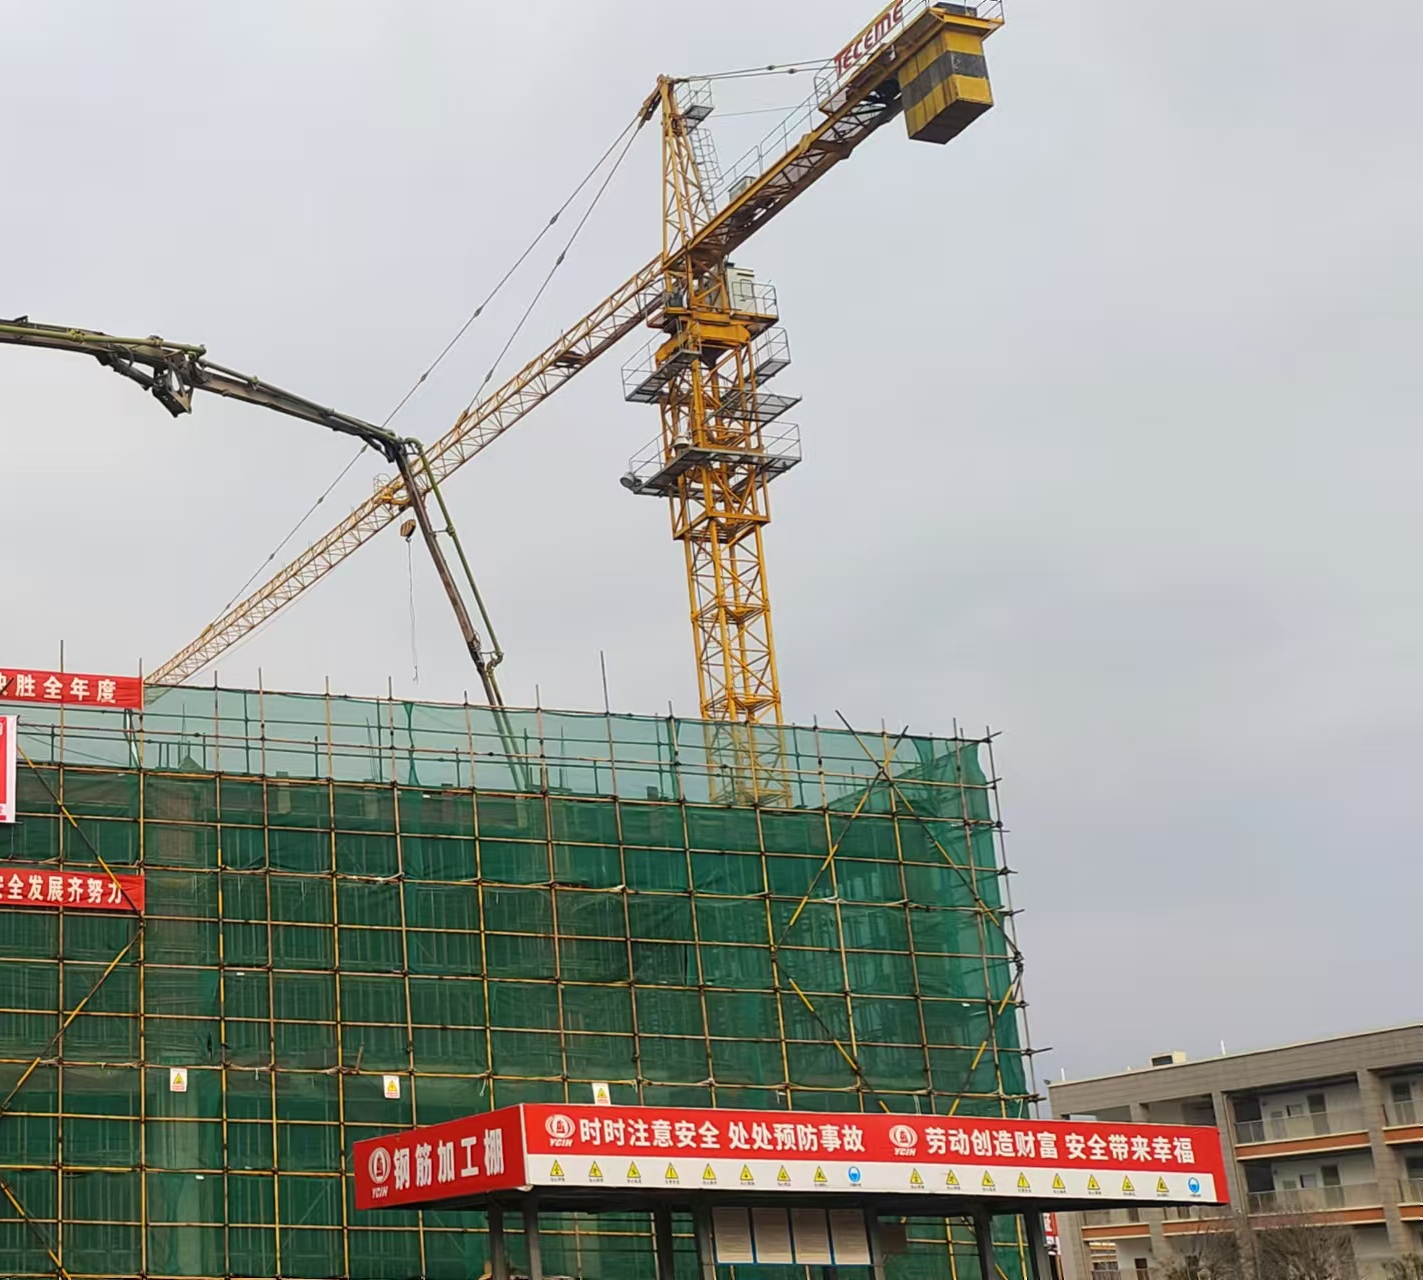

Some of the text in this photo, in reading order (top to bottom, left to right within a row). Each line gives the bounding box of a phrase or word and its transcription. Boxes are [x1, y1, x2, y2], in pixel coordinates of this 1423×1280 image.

[580, 1116, 865, 1153] 时时注意安全 处处预防事故
[925, 1126, 1195, 1164] 劳动创造财富 安全带来幸福
[394, 1128, 504, 1191] 钢筋加工棚
